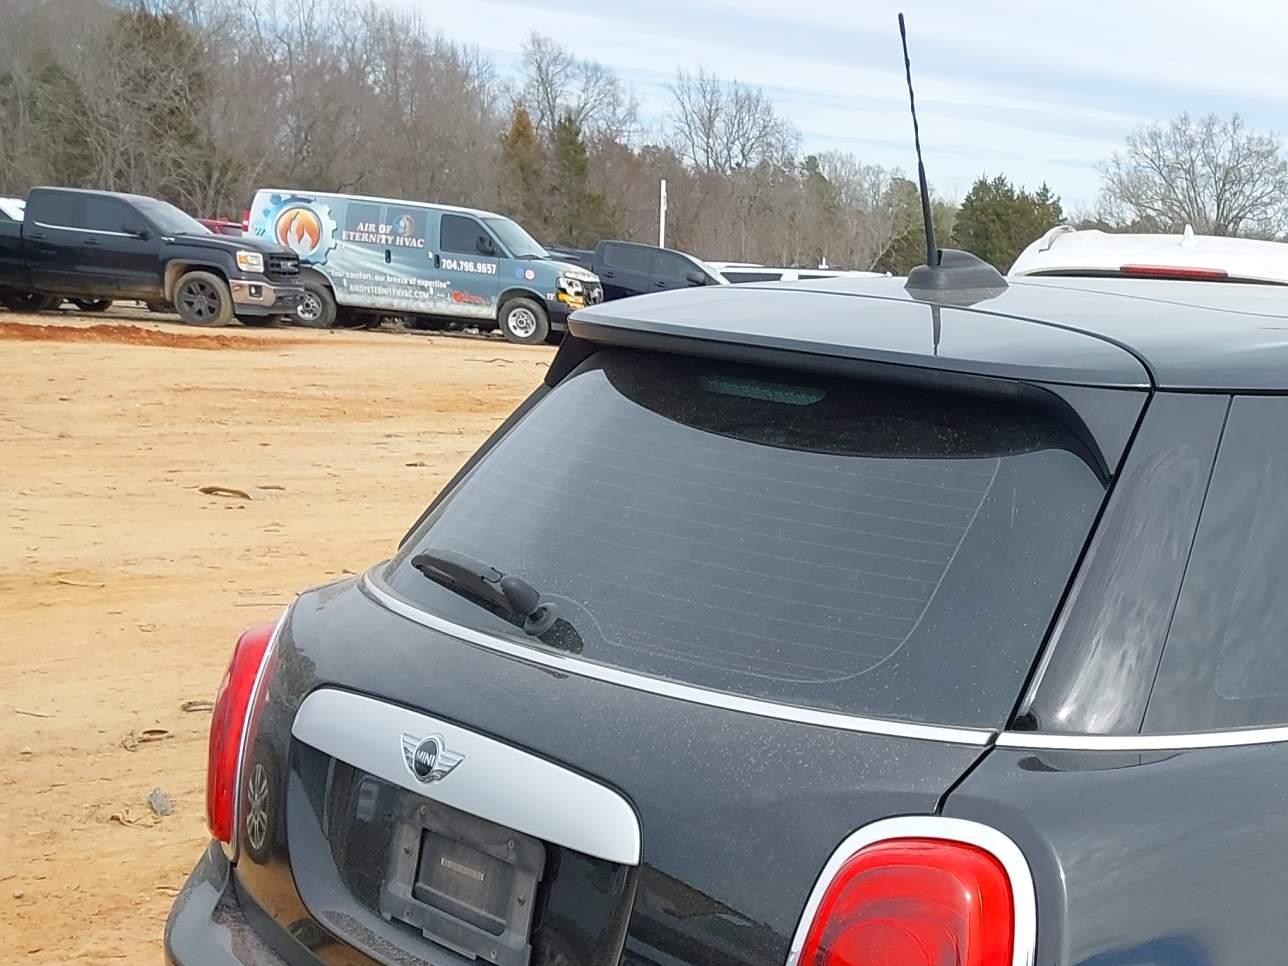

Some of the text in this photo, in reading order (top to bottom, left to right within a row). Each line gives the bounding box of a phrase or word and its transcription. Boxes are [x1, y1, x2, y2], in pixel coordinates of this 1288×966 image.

[357, 222, 392, 234] AIR OF
[342, 230, 425, 248] ETERNITY HVAC
[416, 749, 437, 768] MINI
